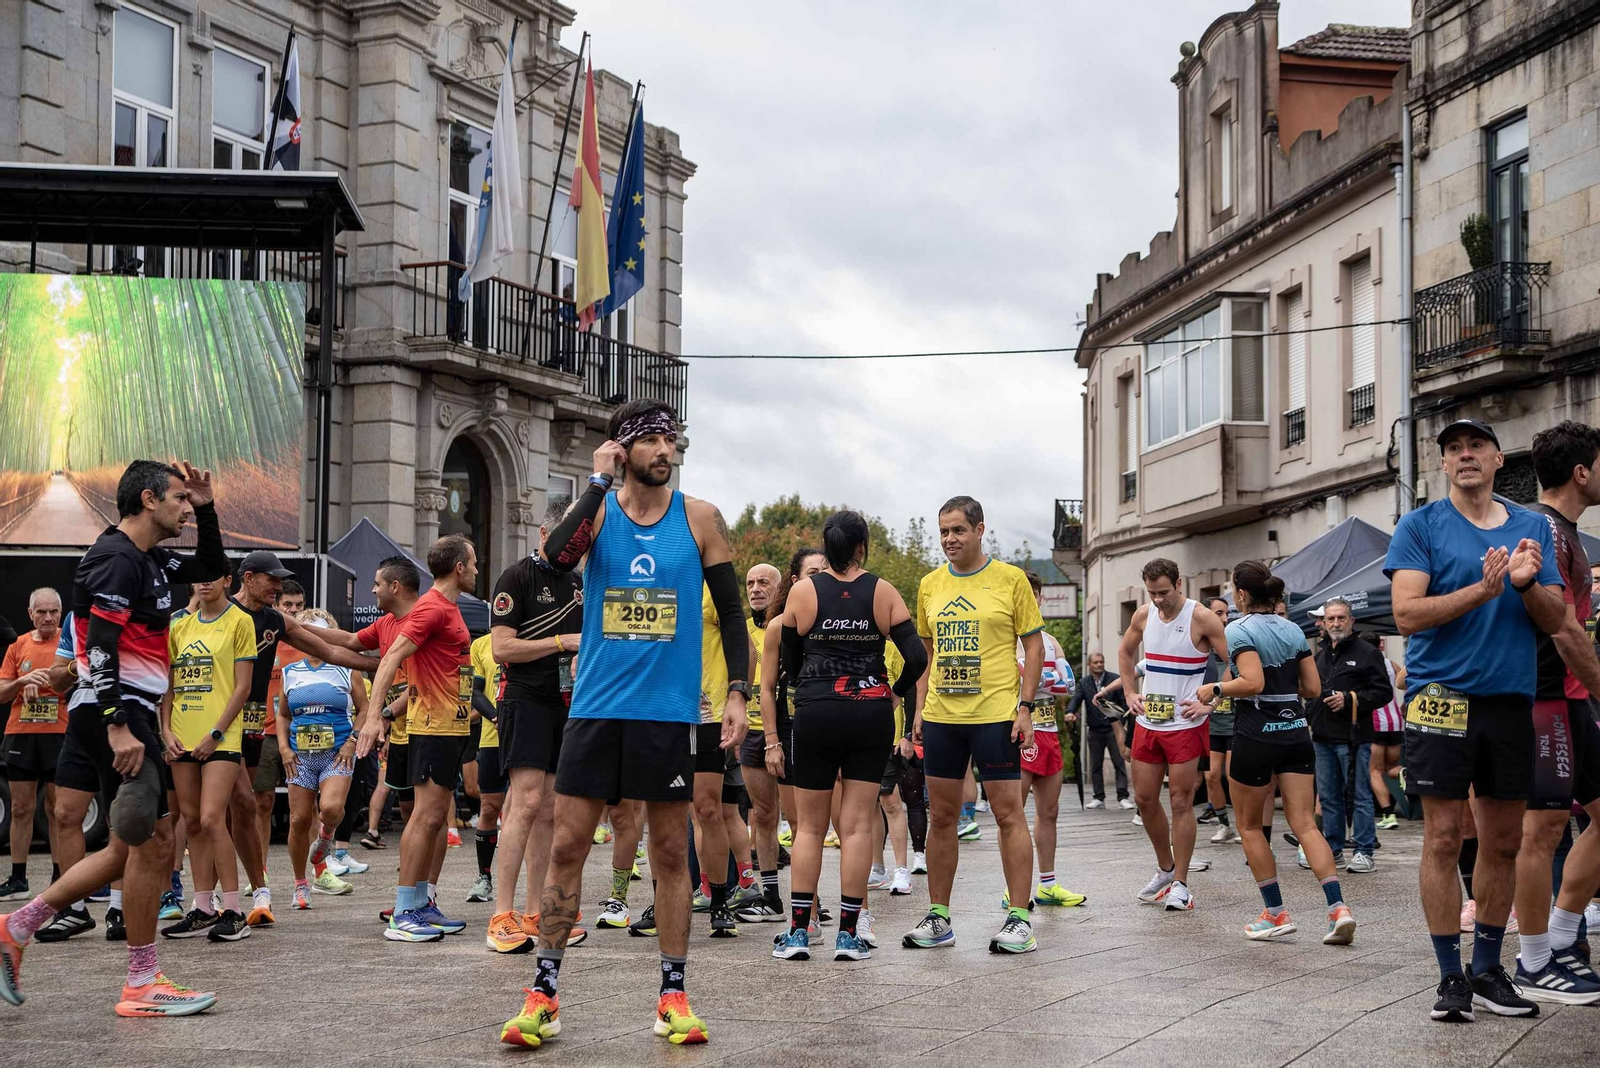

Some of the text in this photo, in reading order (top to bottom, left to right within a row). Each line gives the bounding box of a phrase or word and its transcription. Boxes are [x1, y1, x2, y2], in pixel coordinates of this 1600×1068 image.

[620, 605, 658, 622] 290
[627, 623, 652, 631] OSCAR
[822, 618, 869, 630] CARMA
[936, 620, 972, 637] ENTRE
[829, 633, 880, 642] MARISQUEIRO
[937, 636, 980, 654] PONTES
[180, 667, 201, 680] 249
[943, 668, 968, 681] 285
[29, 704, 49, 714] 482
[1147, 703, 1166, 713] 364
[1418, 699, 1451, 718] 432
[1419, 715, 1445, 725] CARLOS
[308, 733, 321, 744] 79
[1539, 734, 1551, 759] TRAIL
[153, 993, 196, 1002] BROOKS
